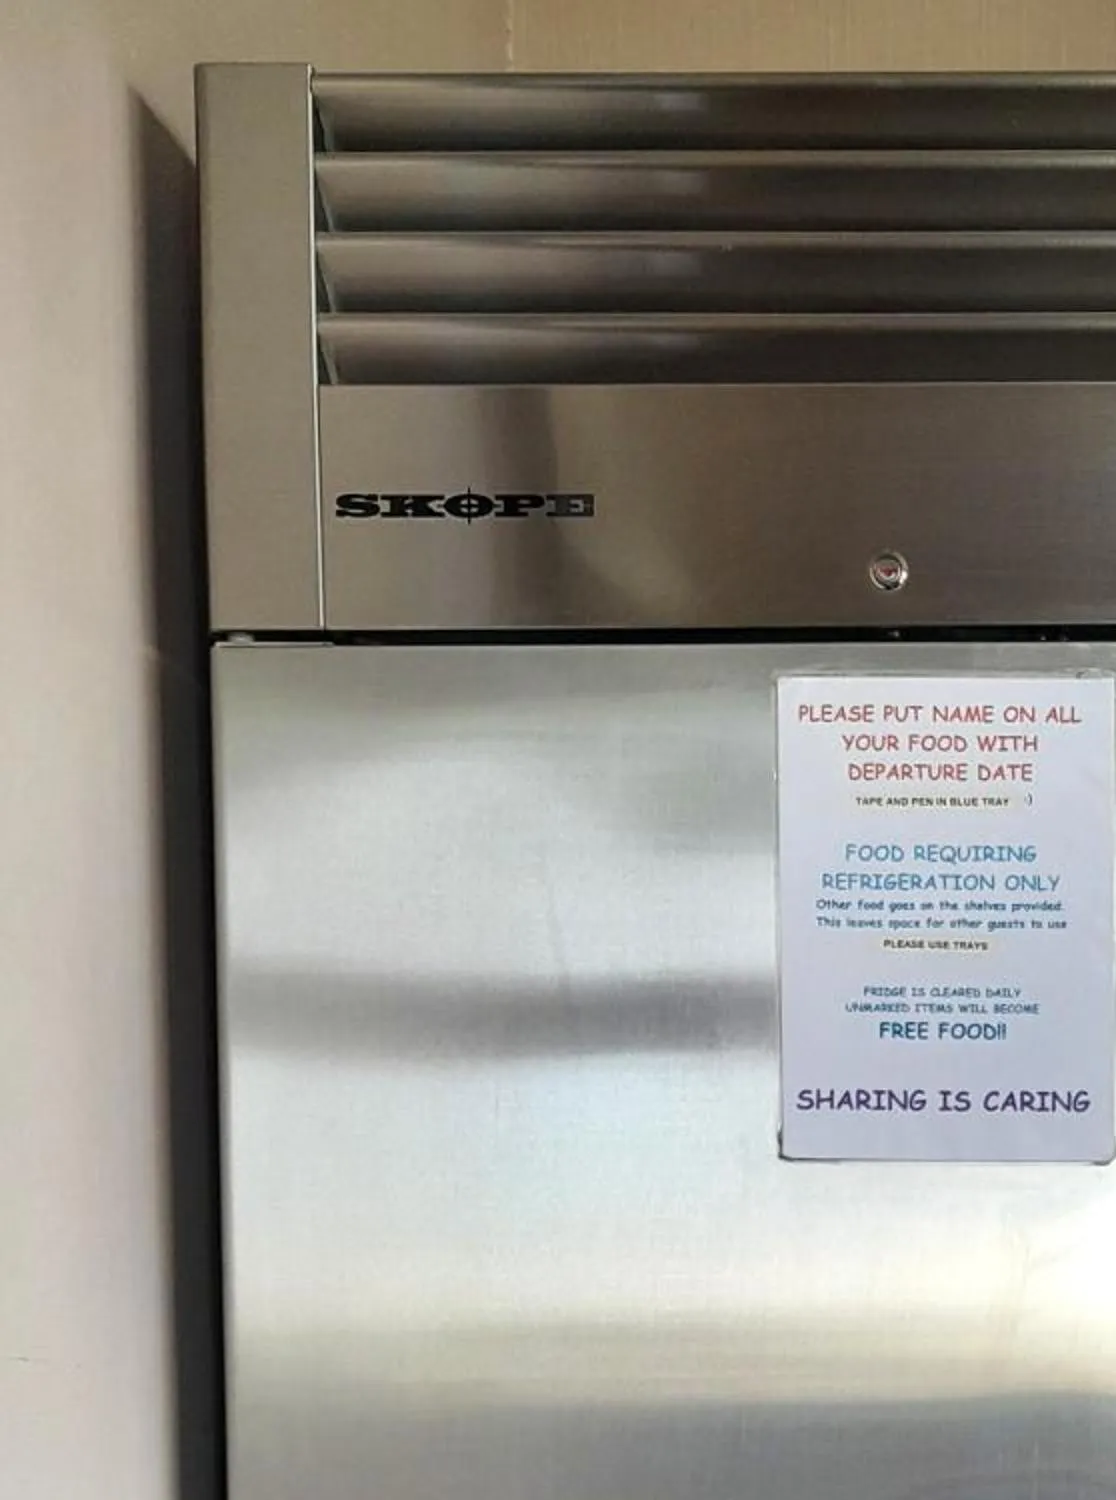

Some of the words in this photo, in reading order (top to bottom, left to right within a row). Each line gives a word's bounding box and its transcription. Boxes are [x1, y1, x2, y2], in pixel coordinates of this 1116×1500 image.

[336, 487, 594, 524] SKOPE
[799, 705, 874, 723] PLEASE
[884, 706, 923, 723] PUT
[932, 706, 993, 723] NAME
[1003, 706, 1036, 723] ON
[1045, 706, 1082, 723] ALL
[842, 735, 899, 752] YOUR
[908, 735, 967, 752] FOOD
[977, 735, 1039, 752] WITH
[849, 763, 968, 782] DEPARTURE
[978, 764, 1034, 782] DATE
[856, 797, 882, 807] TAPE
[887, 797, 909, 807] AND
[911, 797, 933, 807] PEN
[935, 797, 948, 807] IN
[950, 797, 979, 807] BLUE
[982, 797, 1010, 807] TRAY
[845, 844, 905, 862] FOOD
[914, 845, 1038, 864] REQUIRING
[822, 873, 995, 891] REFRIGERATION
[1005, 874, 1061, 892] ONLY
[815, 899, 851, 910] Other
[857, 899, 884, 911] food
[889, 902, 915, 913] goes
[920, 902, 934, 911] on
[939, 900, 958, 911] the
[964, 900, 1007, 911] shelves
[816, 916, 841, 928] This
[846, 916, 883, 928] leaves
[888, 919, 920, 930] space
[926, 917, 944, 929] for
[950, 918, 983, 929] other
[987, 920, 1025, 932] guests
[1031, 919, 1043, 929] to
[1047, 920, 1067, 929] use
[883, 939, 925, 950] PLEASE
[928, 940, 951, 950] USE
[953, 940, 989, 951] TRAYS
[863, 986, 906, 997] FRIDGE
[911, 987, 926, 997] IS
[929, 987, 981, 998] CLEARED
[985, 987, 1022, 998] DAILY
[845, 1002, 911, 1014] UNMARKED
[914, 1003, 953, 1014] ITEMS
[958, 1003, 988, 1014] WILL
[993, 1003, 1040, 1014] BECOME
[879, 1021, 929, 1040] FREE
[938, 1022, 1007, 1041] FOOD!!
[797, 1089, 927, 1112] SHARING
[939, 1090, 972, 1112] IS
[983, 1090, 1091, 1114] CARING
